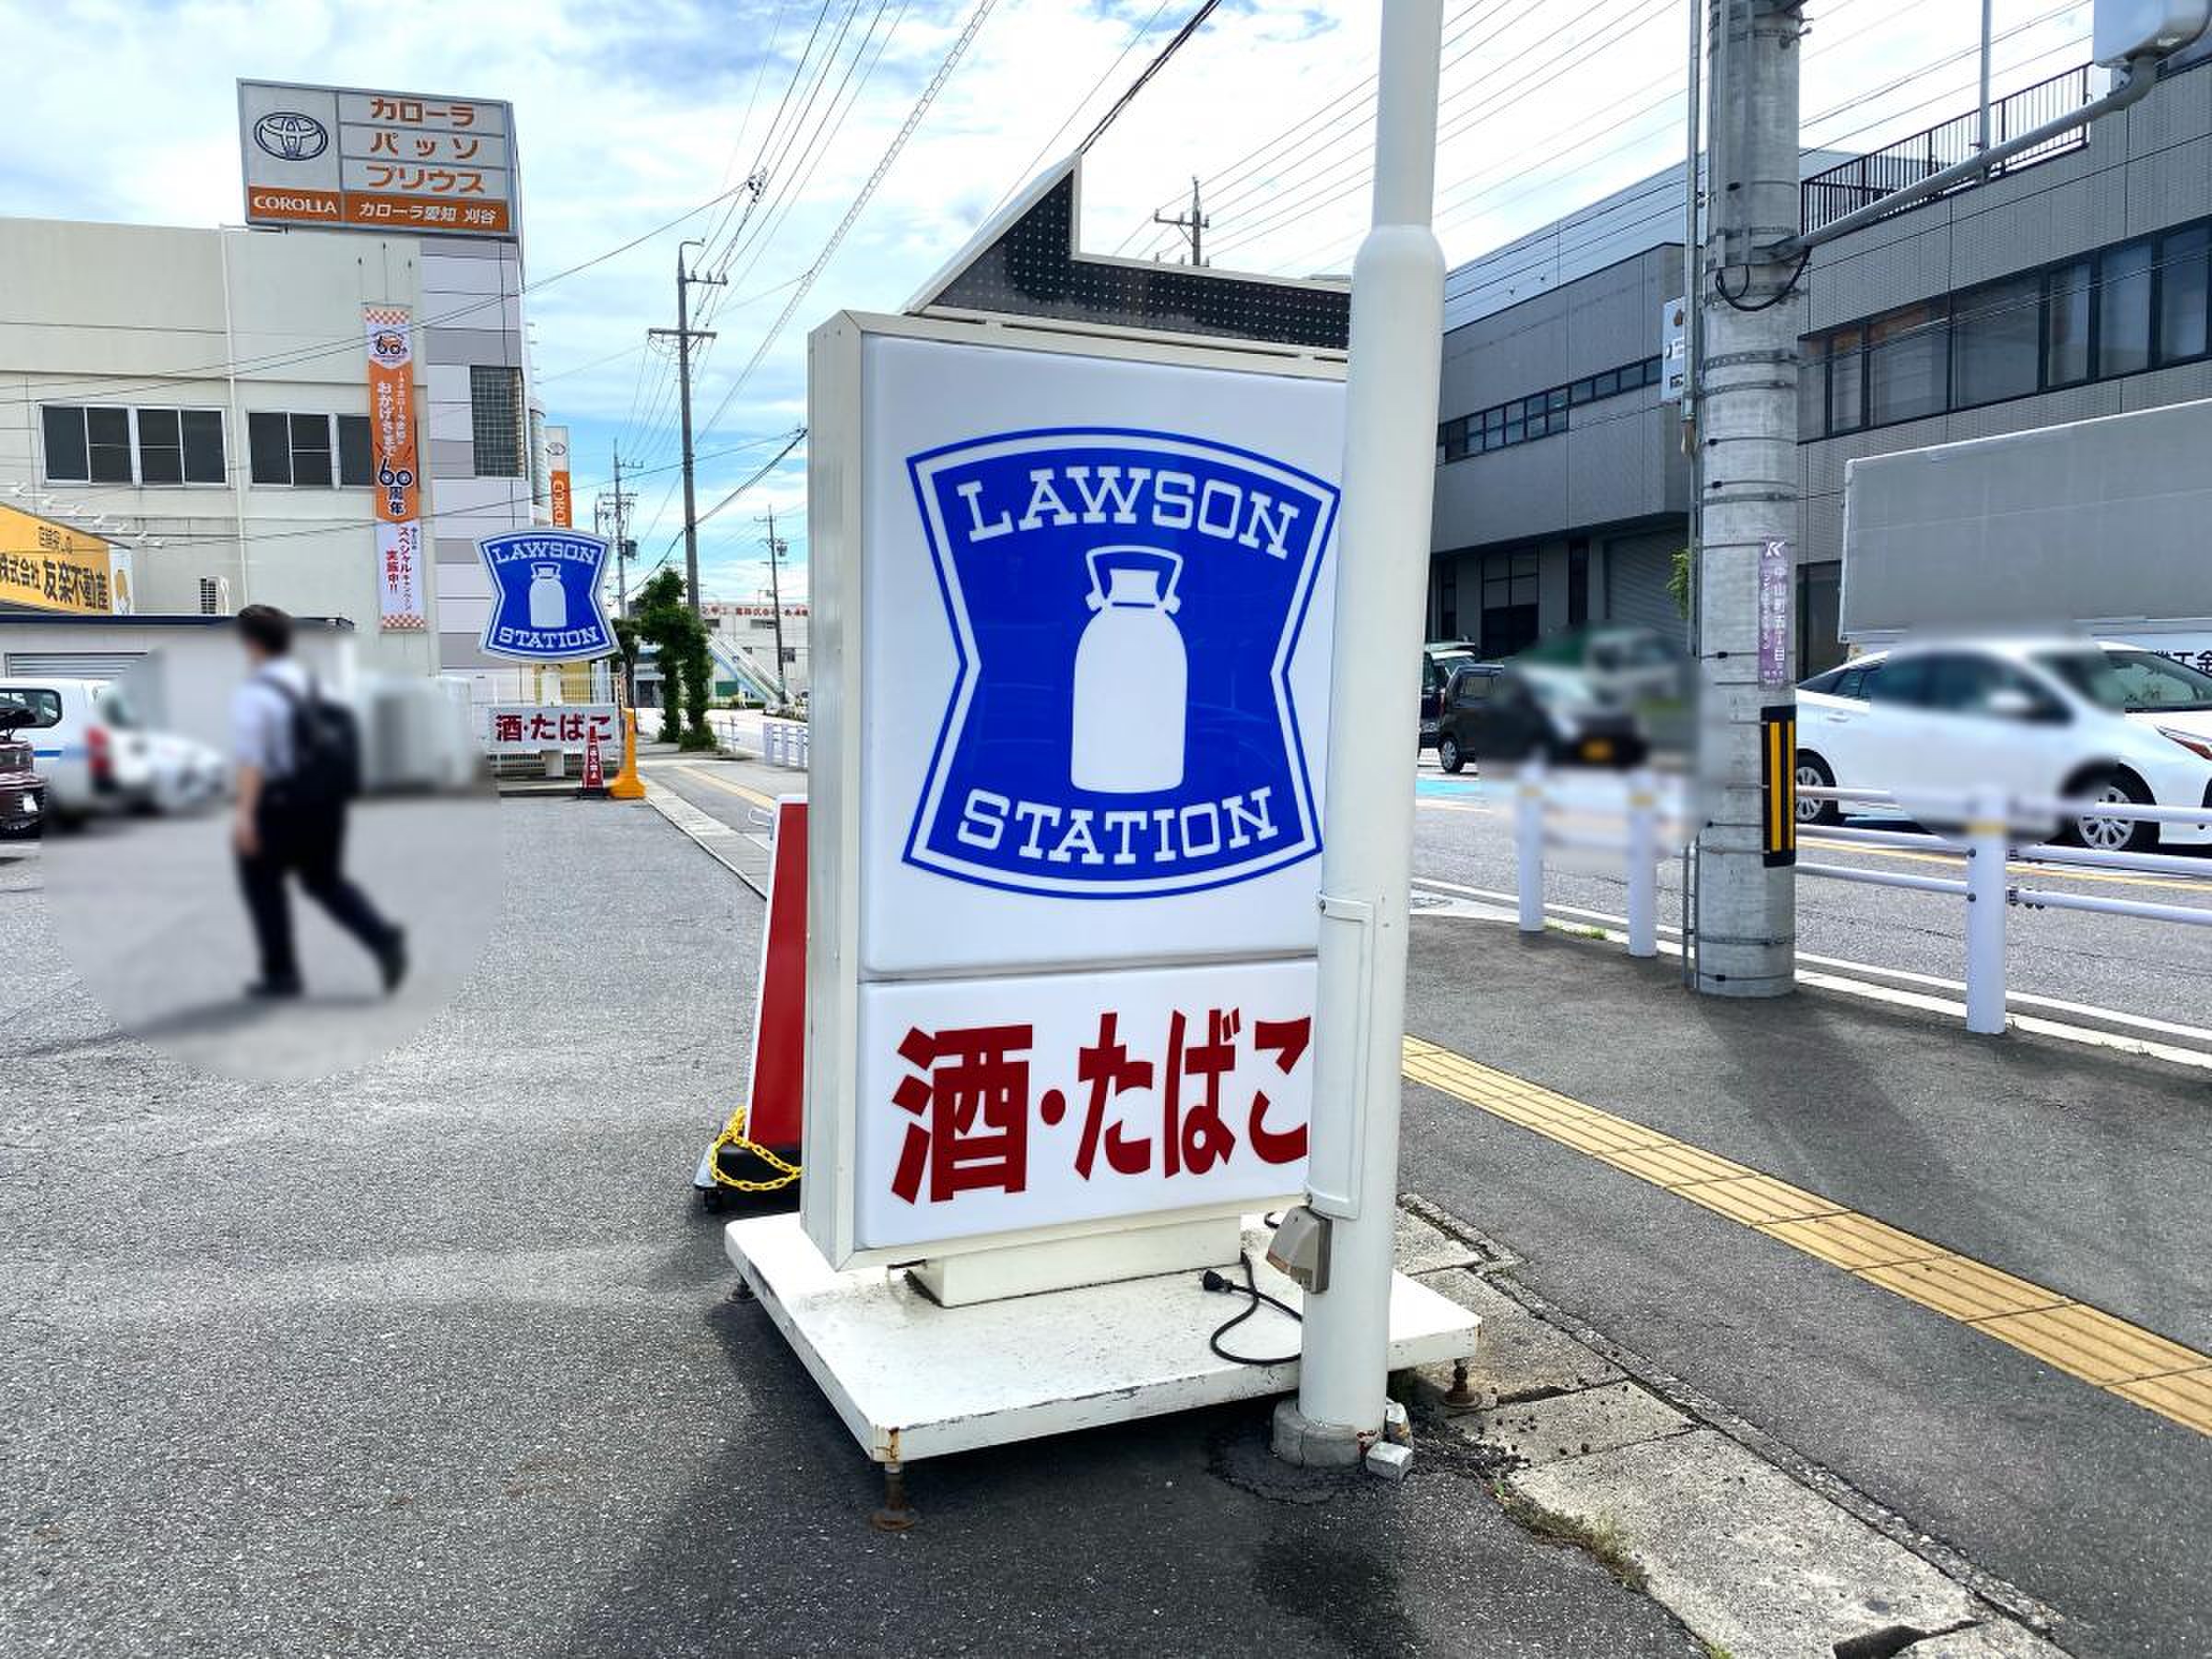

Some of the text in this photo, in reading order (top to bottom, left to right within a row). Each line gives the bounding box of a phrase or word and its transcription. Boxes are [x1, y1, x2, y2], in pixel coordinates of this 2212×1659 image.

[371, 98, 475, 127] カローラ
[371, 132, 479, 159] パッソ
[366, 166, 486, 194] プリウス
[253, 194, 337, 214] COROLLA
[359, 201, 497, 225] カローラ愛知 刈谷
[957, 466, 1300, 560] LAWSON
[493, 542, 597, 565] LAWSON
[499, 626, 599, 648] STATION
[496, 713, 611, 742] 酒・たばこ
[957, 786, 1279, 866] STATION
[890, 1006, 1312, 1206] 酒・たばこ
